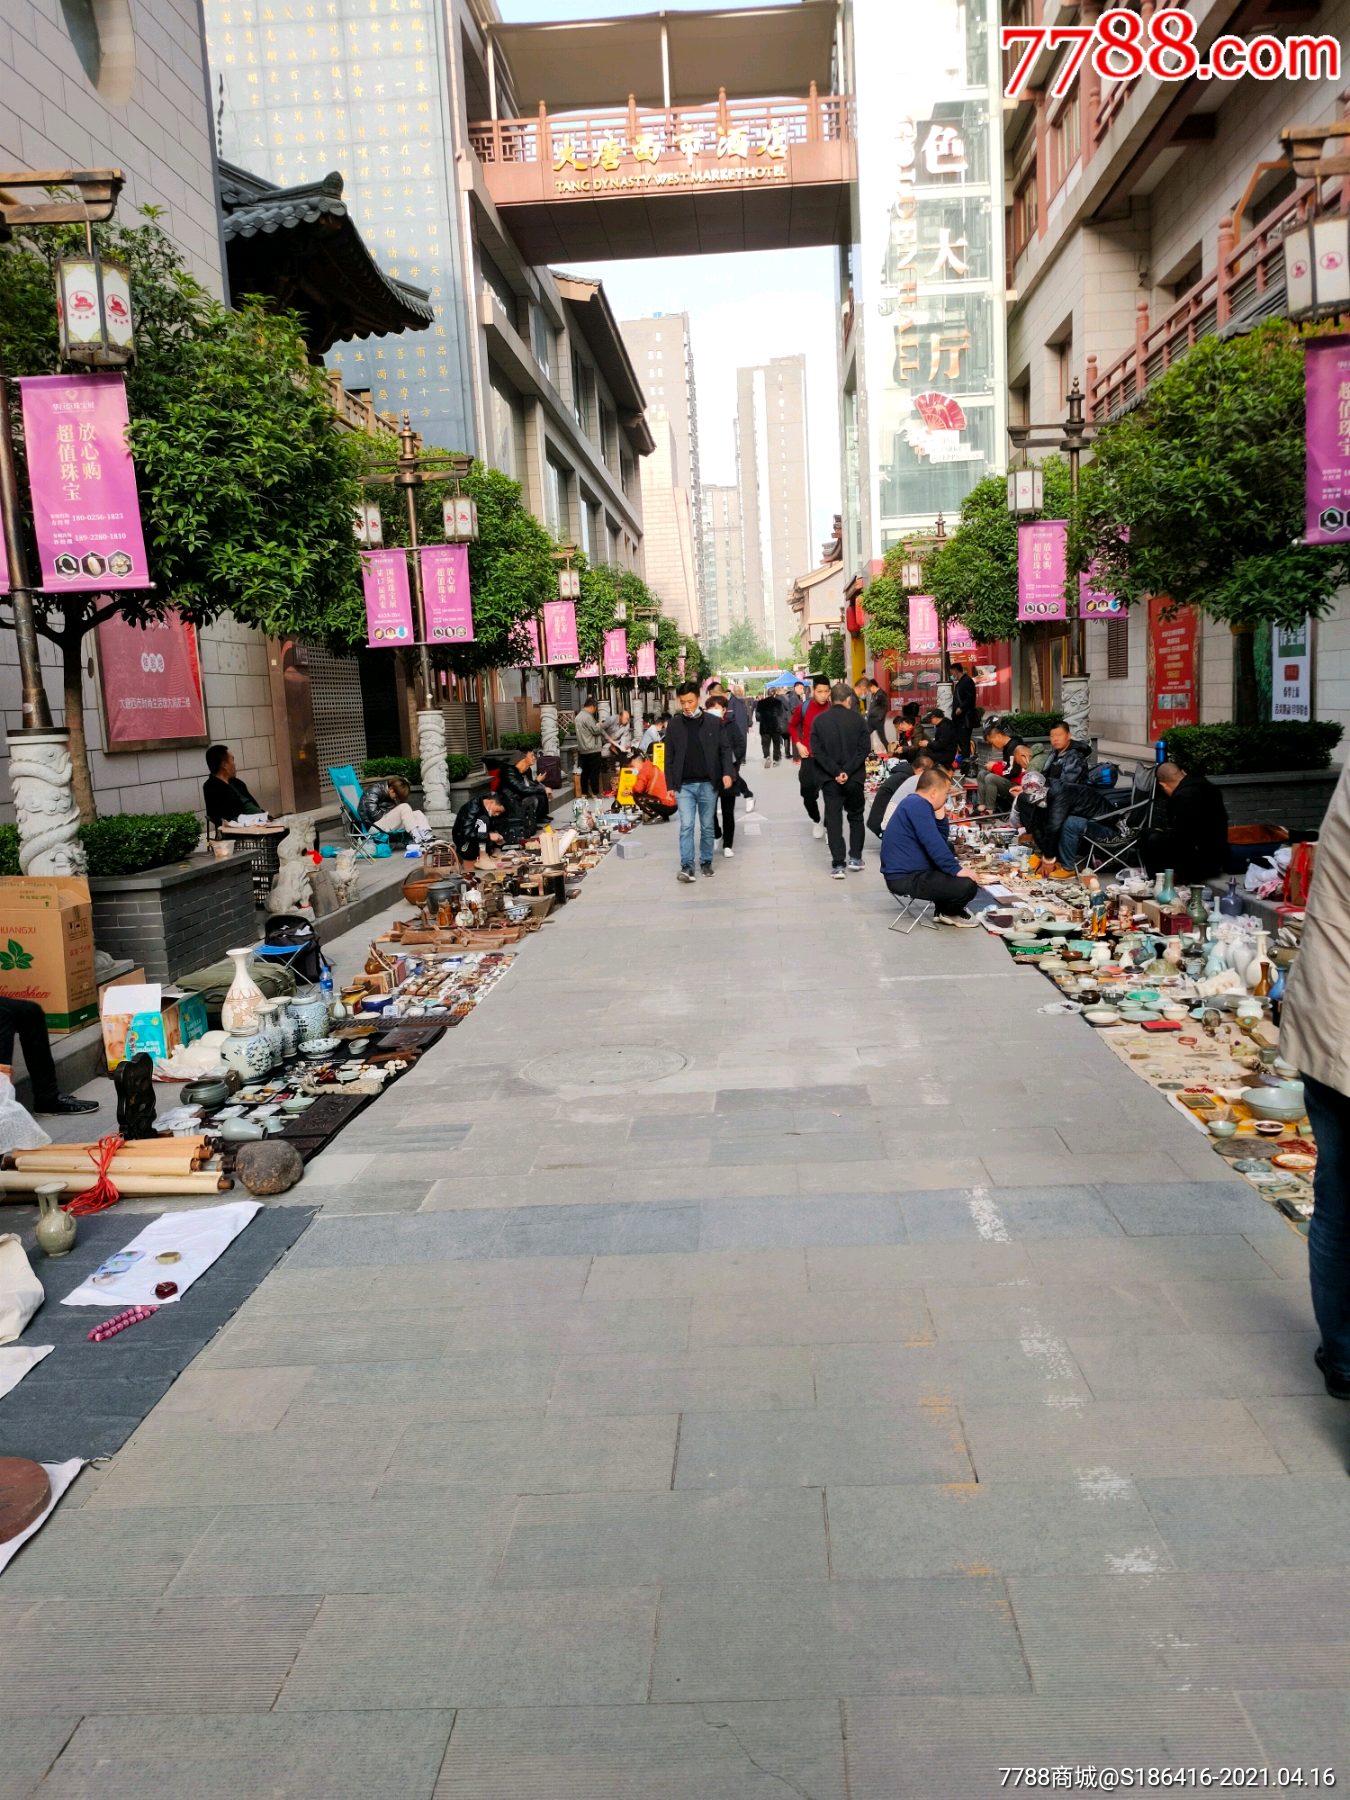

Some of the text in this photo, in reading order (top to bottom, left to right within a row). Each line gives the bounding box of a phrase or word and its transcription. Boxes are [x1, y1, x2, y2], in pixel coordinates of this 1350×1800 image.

[552, 119, 788, 171] 大唐西市酒店
[556, 164, 787, 195] TANG DYNASTY WEST MARKET HOTEL
[56, 424, 82, 501] 超值珠宝
[79, 423, 102, 481] 放心购
